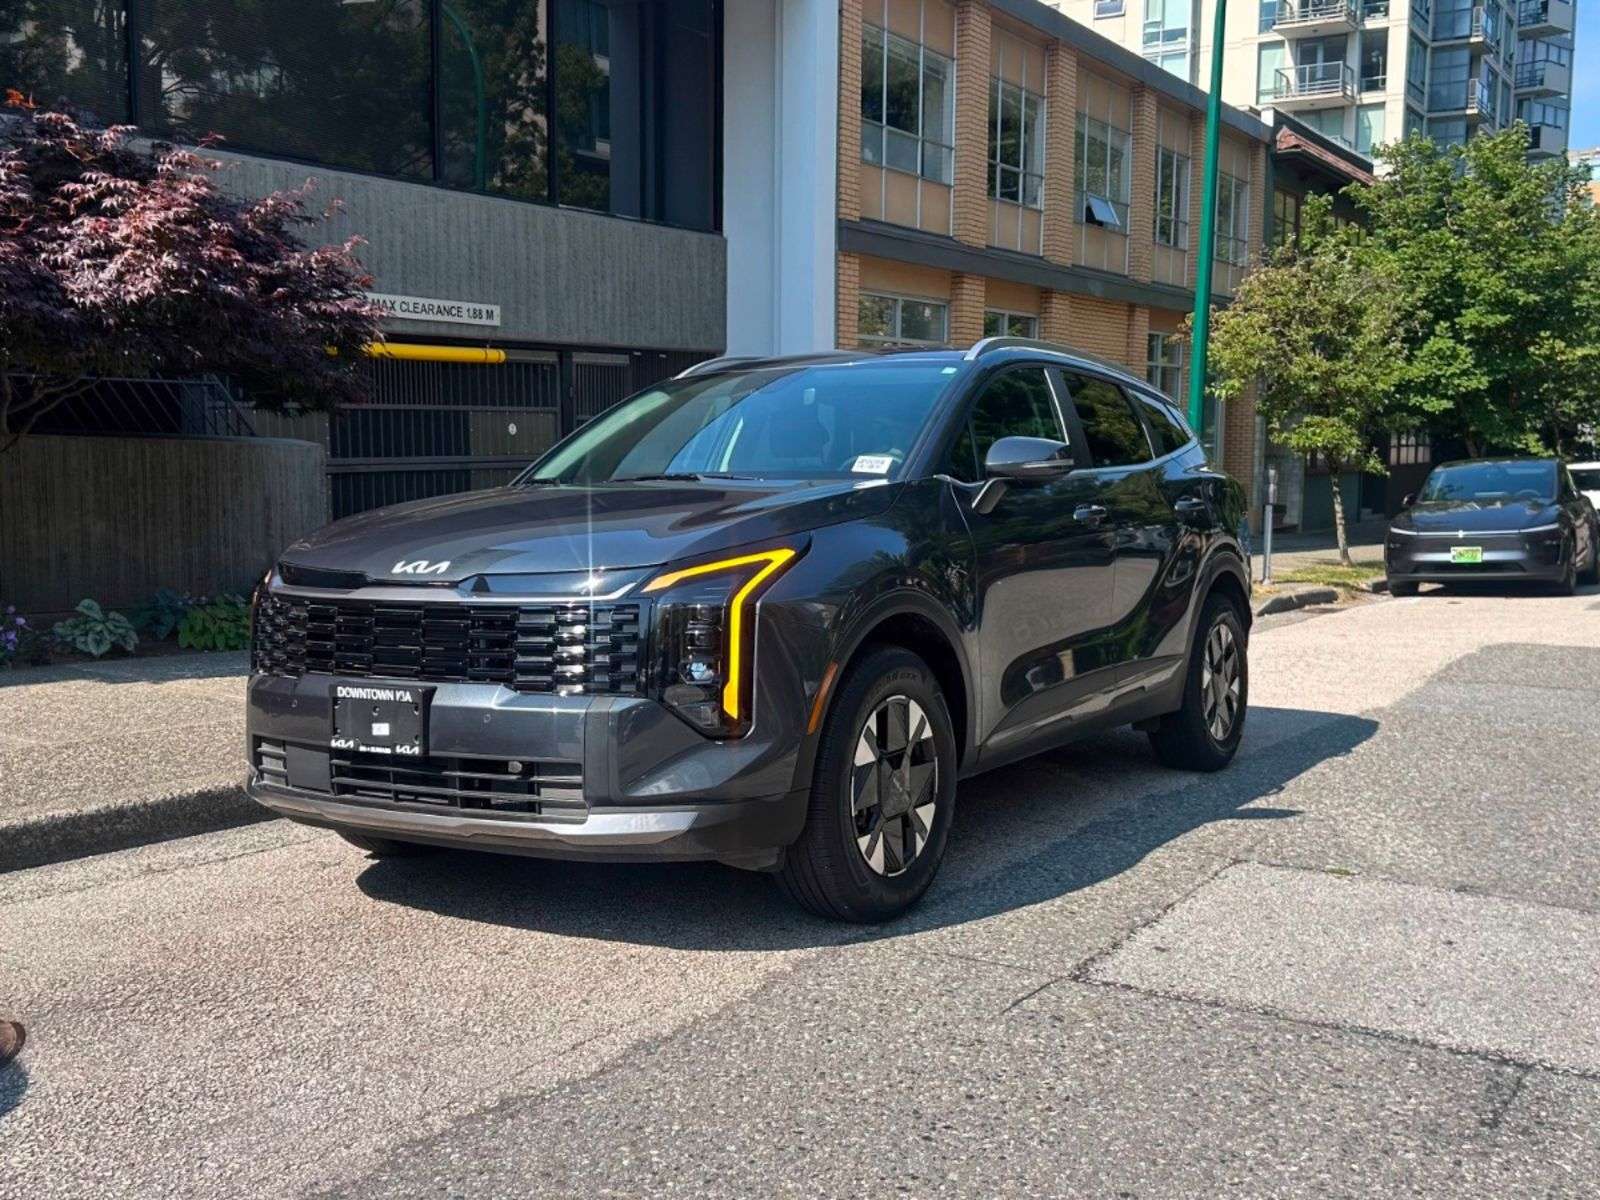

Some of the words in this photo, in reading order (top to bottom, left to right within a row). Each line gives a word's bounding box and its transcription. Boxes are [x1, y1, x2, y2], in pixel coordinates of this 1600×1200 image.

[400, 301, 464, 318] CLEARANCE
[486, 309, 495, 321] M
[391, 560, 452, 574] KIA
[337, 686, 394, 701] DOWNTOWN
[395, 690, 413, 703] KIA
